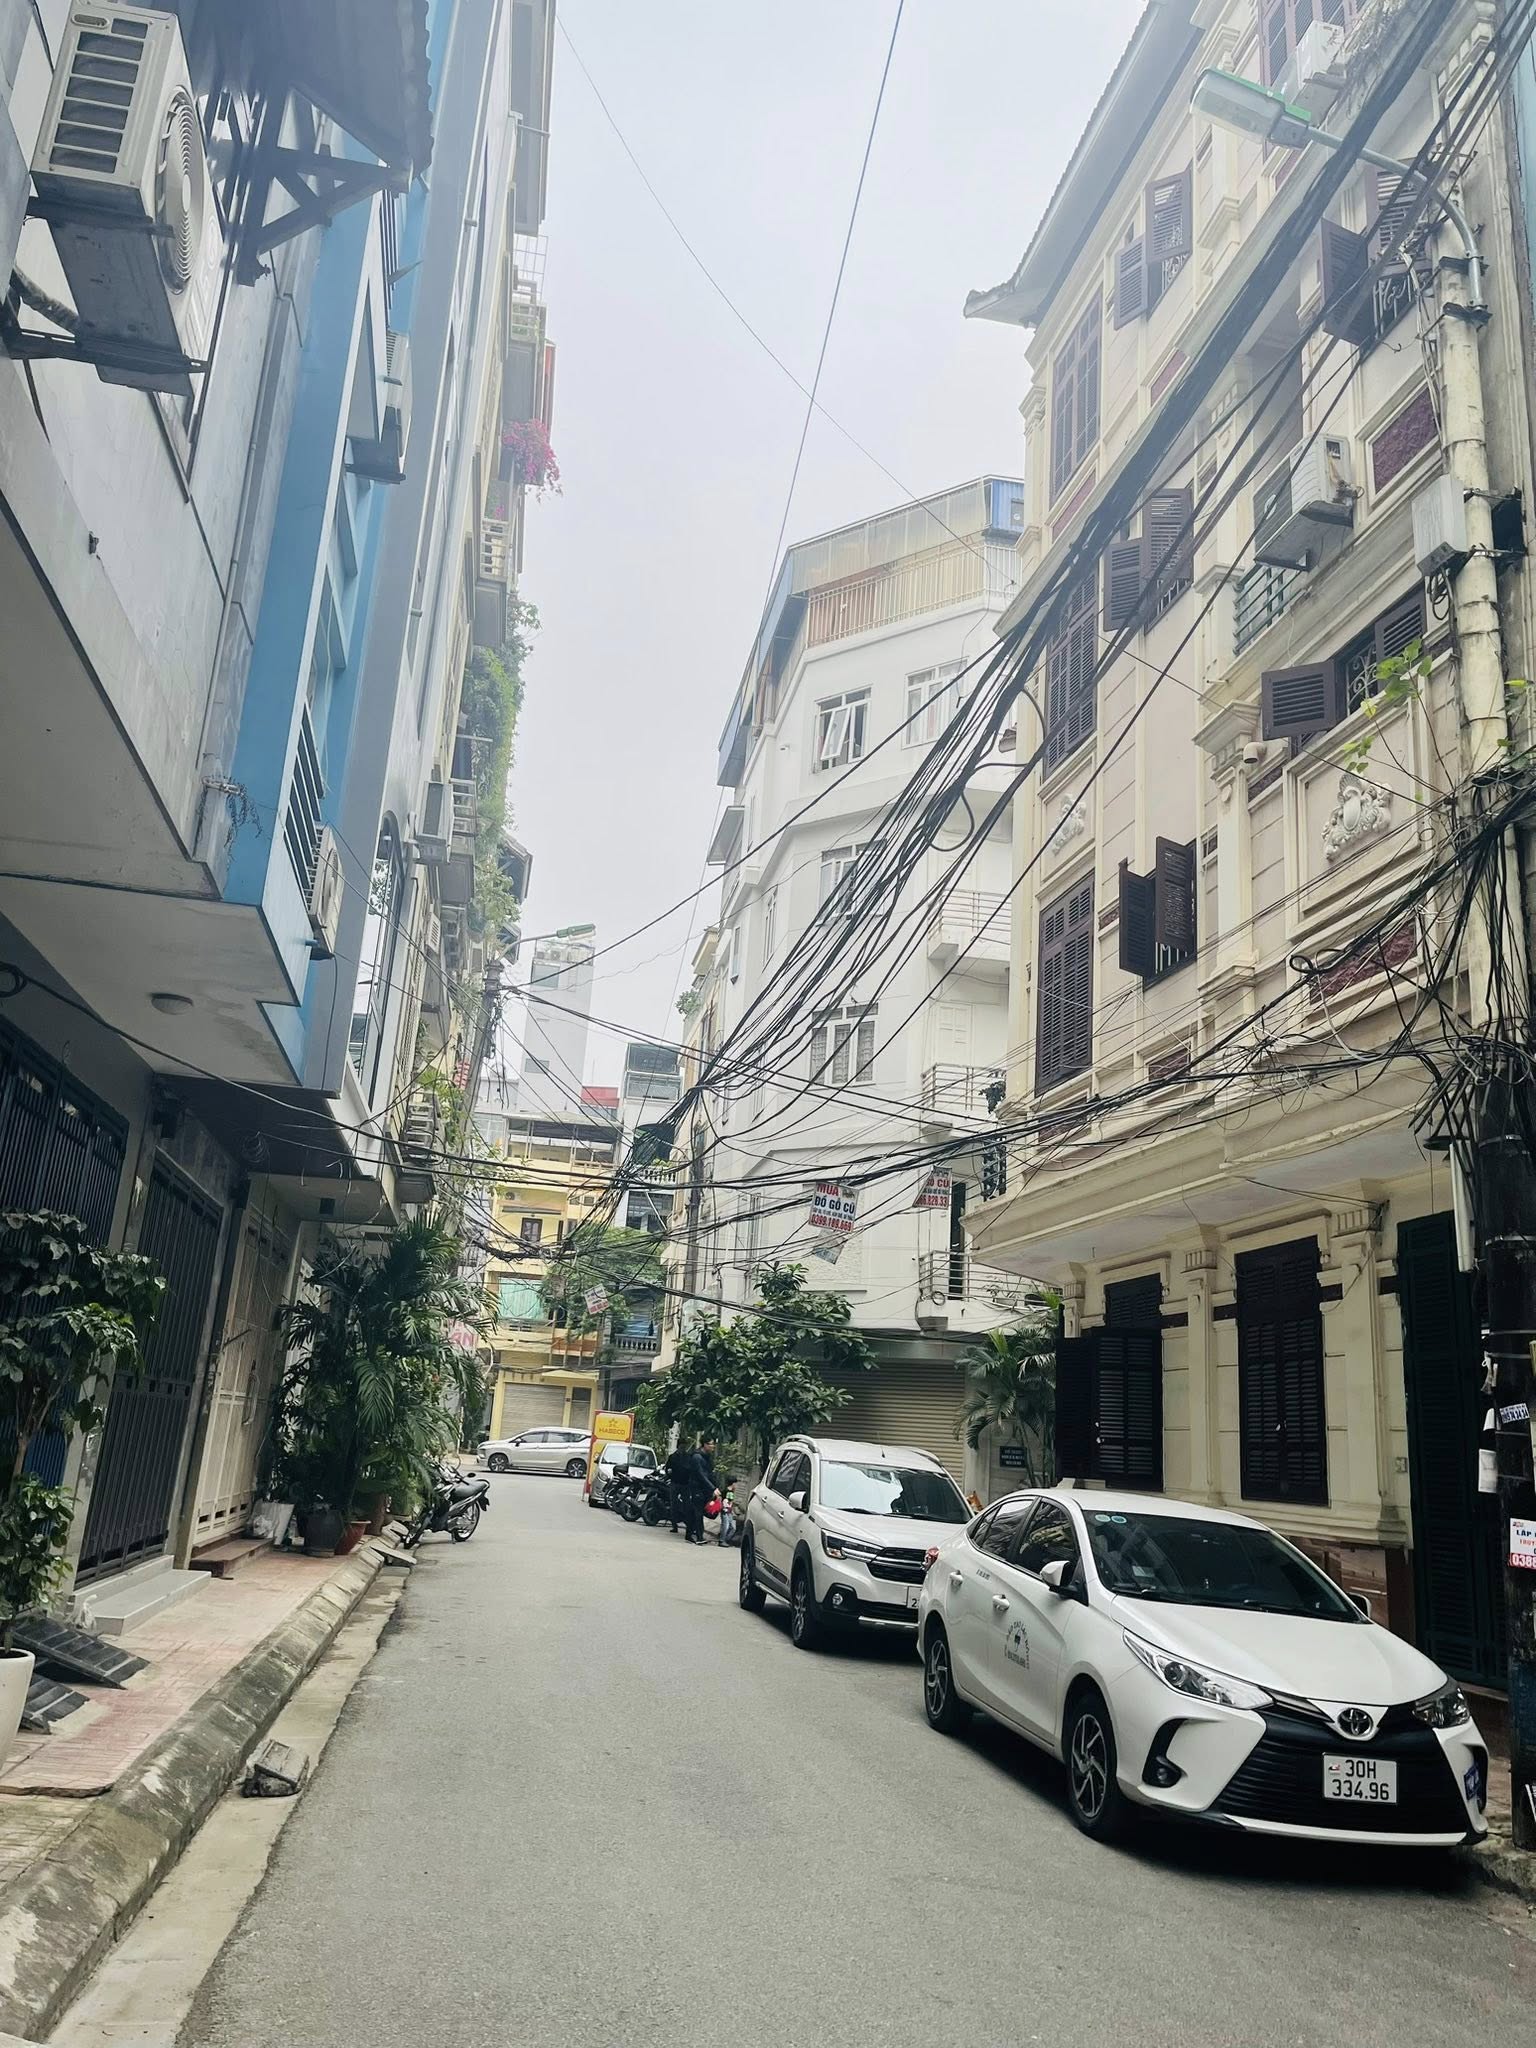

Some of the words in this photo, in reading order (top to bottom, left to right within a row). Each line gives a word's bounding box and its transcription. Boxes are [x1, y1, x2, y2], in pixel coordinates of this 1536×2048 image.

[816, 1183, 839, 1196] MUA
[1345, 1759, 1376, 1779] 30H
[1332, 1779, 1389, 1800] 334.96
